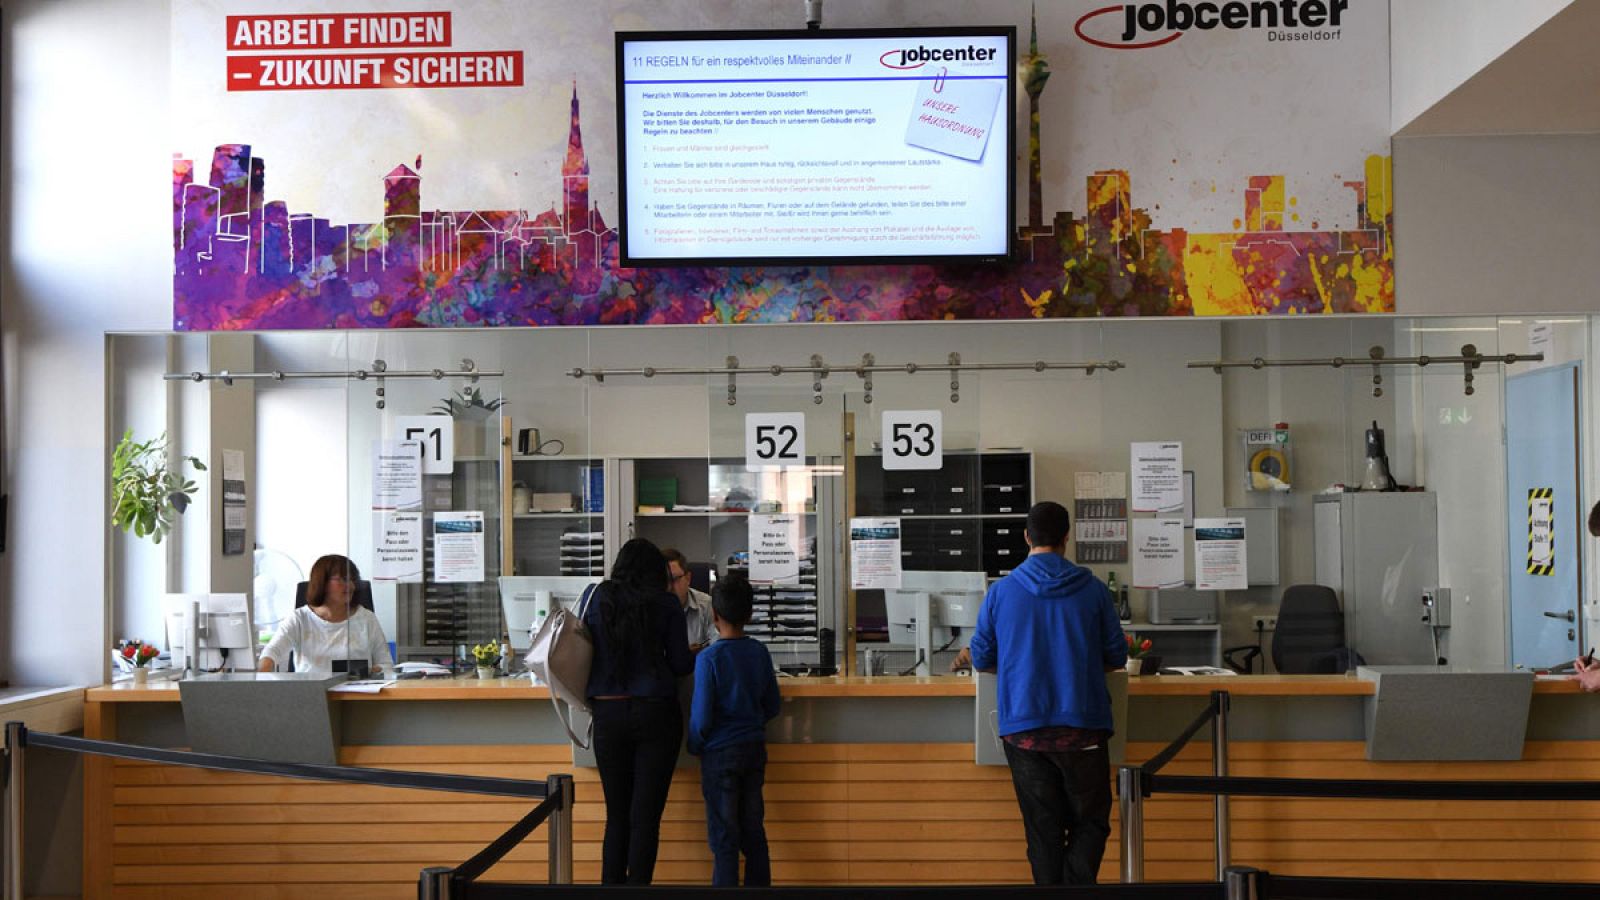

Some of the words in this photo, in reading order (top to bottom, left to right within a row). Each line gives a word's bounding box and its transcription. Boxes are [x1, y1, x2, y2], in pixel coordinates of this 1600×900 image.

[234, 19, 334, 45] ARBEIT
[344, 17, 444, 44] FINDEN
[1121, 0, 1348, 40] jobcenter
[1268, 30, 1341, 41] Düsseldorf
[633, 56, 641, 66] 11
[646, 55, 688, 66] REGELN
[692, 55, 704, 66] für
[706, 55, 720, 66] ein
[724, 54, 784, 68] respektvolles
[787, 54, 842, 65] Miteinander
[900, 45, 996, 65] jobcenter
[259, 58, 385, 86] ZUKUNFT
[393, 56, 514, 83] SICHERN
[923, 99, 959, 113] UNSERE
[919, 113, 984, 138] HAUSORDNUNG
[756, 425, 798, 459] 52
[893, 423, 935, 456] 53
